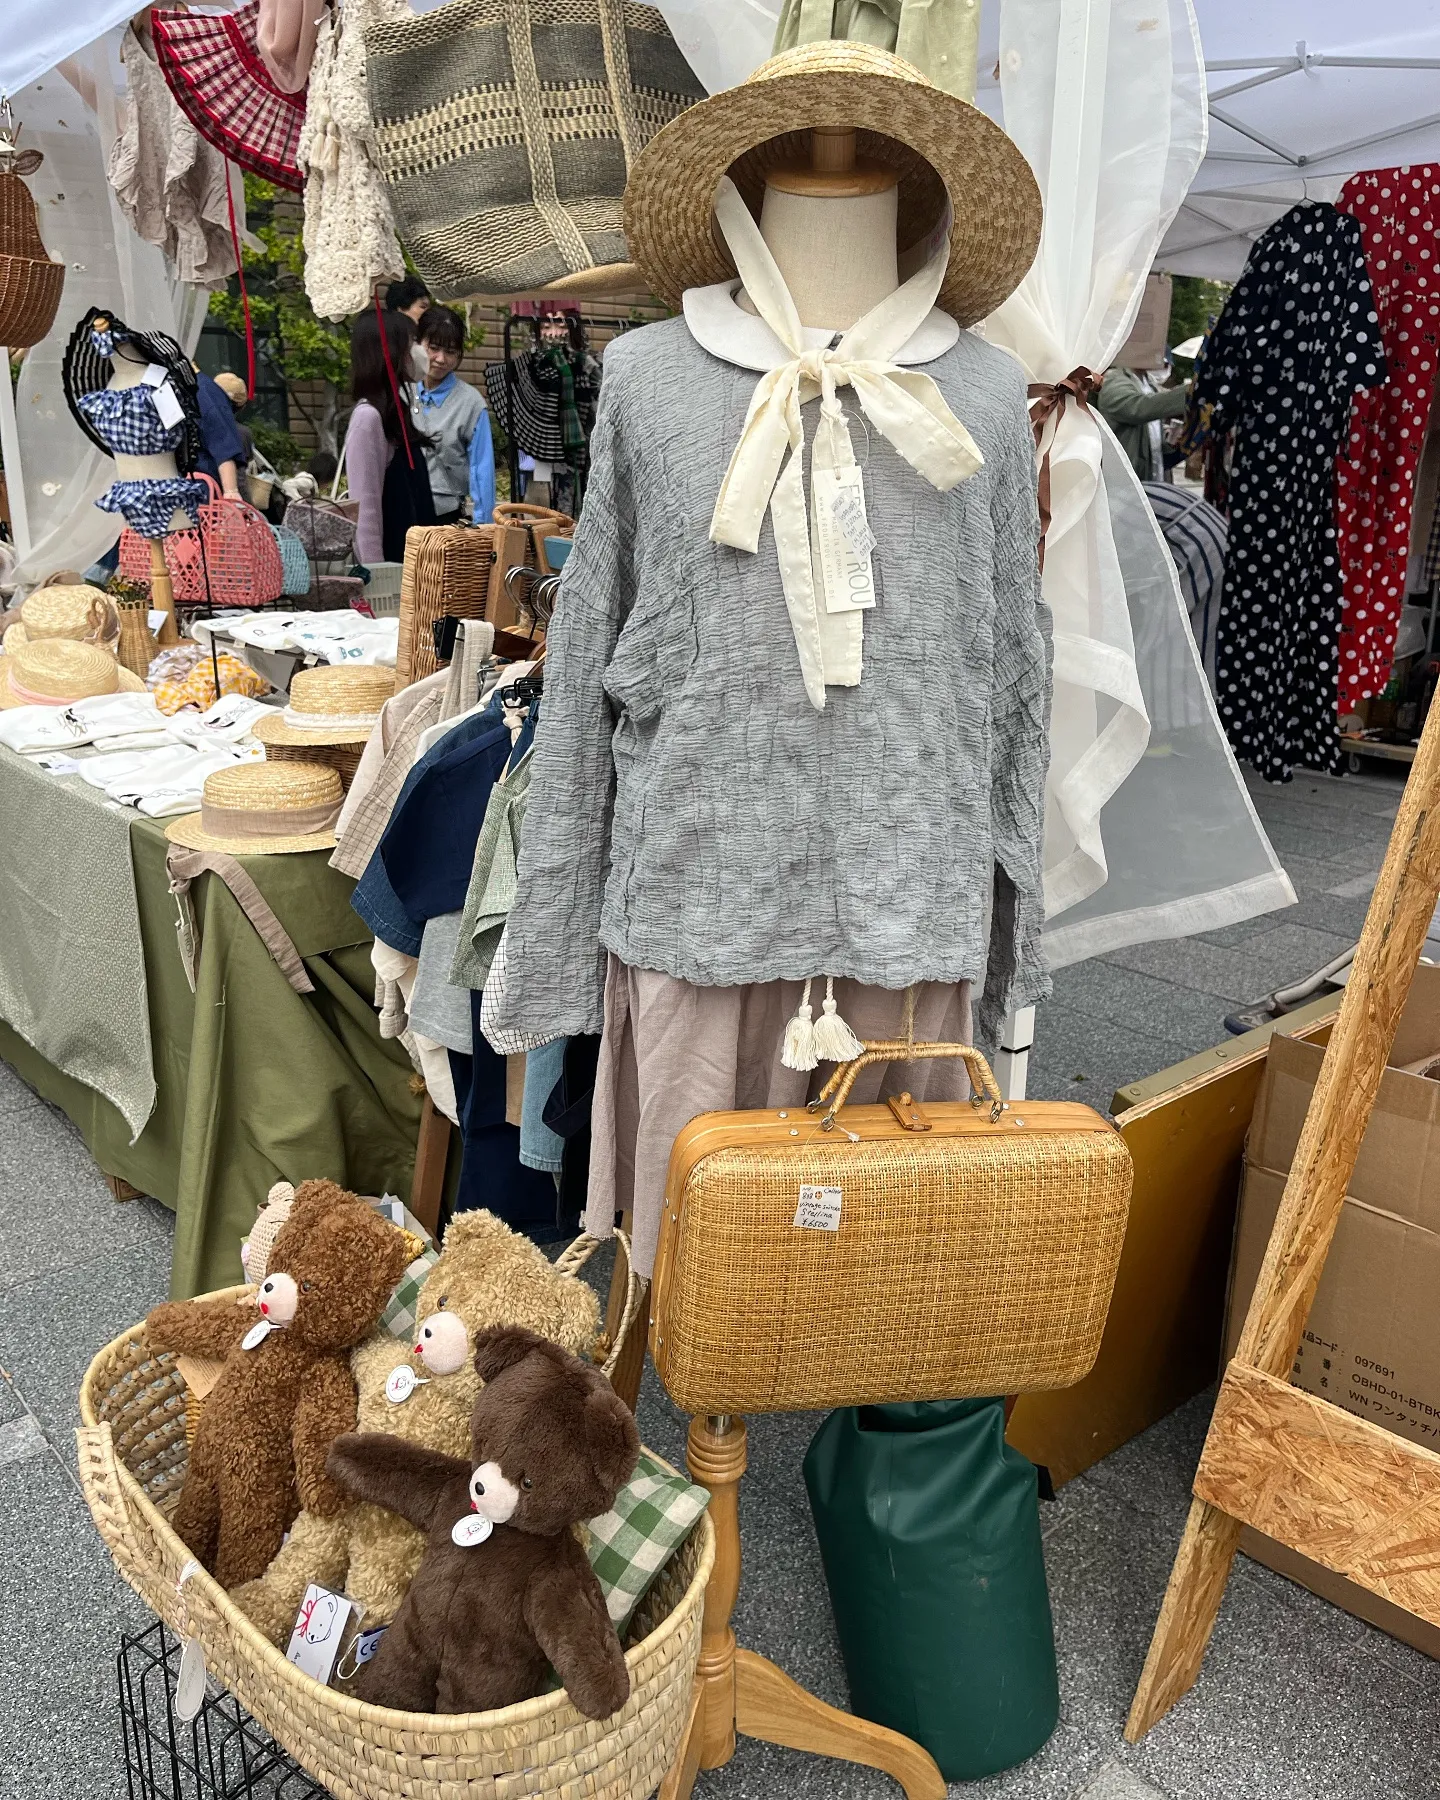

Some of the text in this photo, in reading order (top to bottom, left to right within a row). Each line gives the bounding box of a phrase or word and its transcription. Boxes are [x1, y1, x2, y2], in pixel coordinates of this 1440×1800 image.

[1355, 1355, 1395, 1380] 097691
[1348, 1389, 1369, 1406] WN
[360, 1638, 379, 1656] CE
